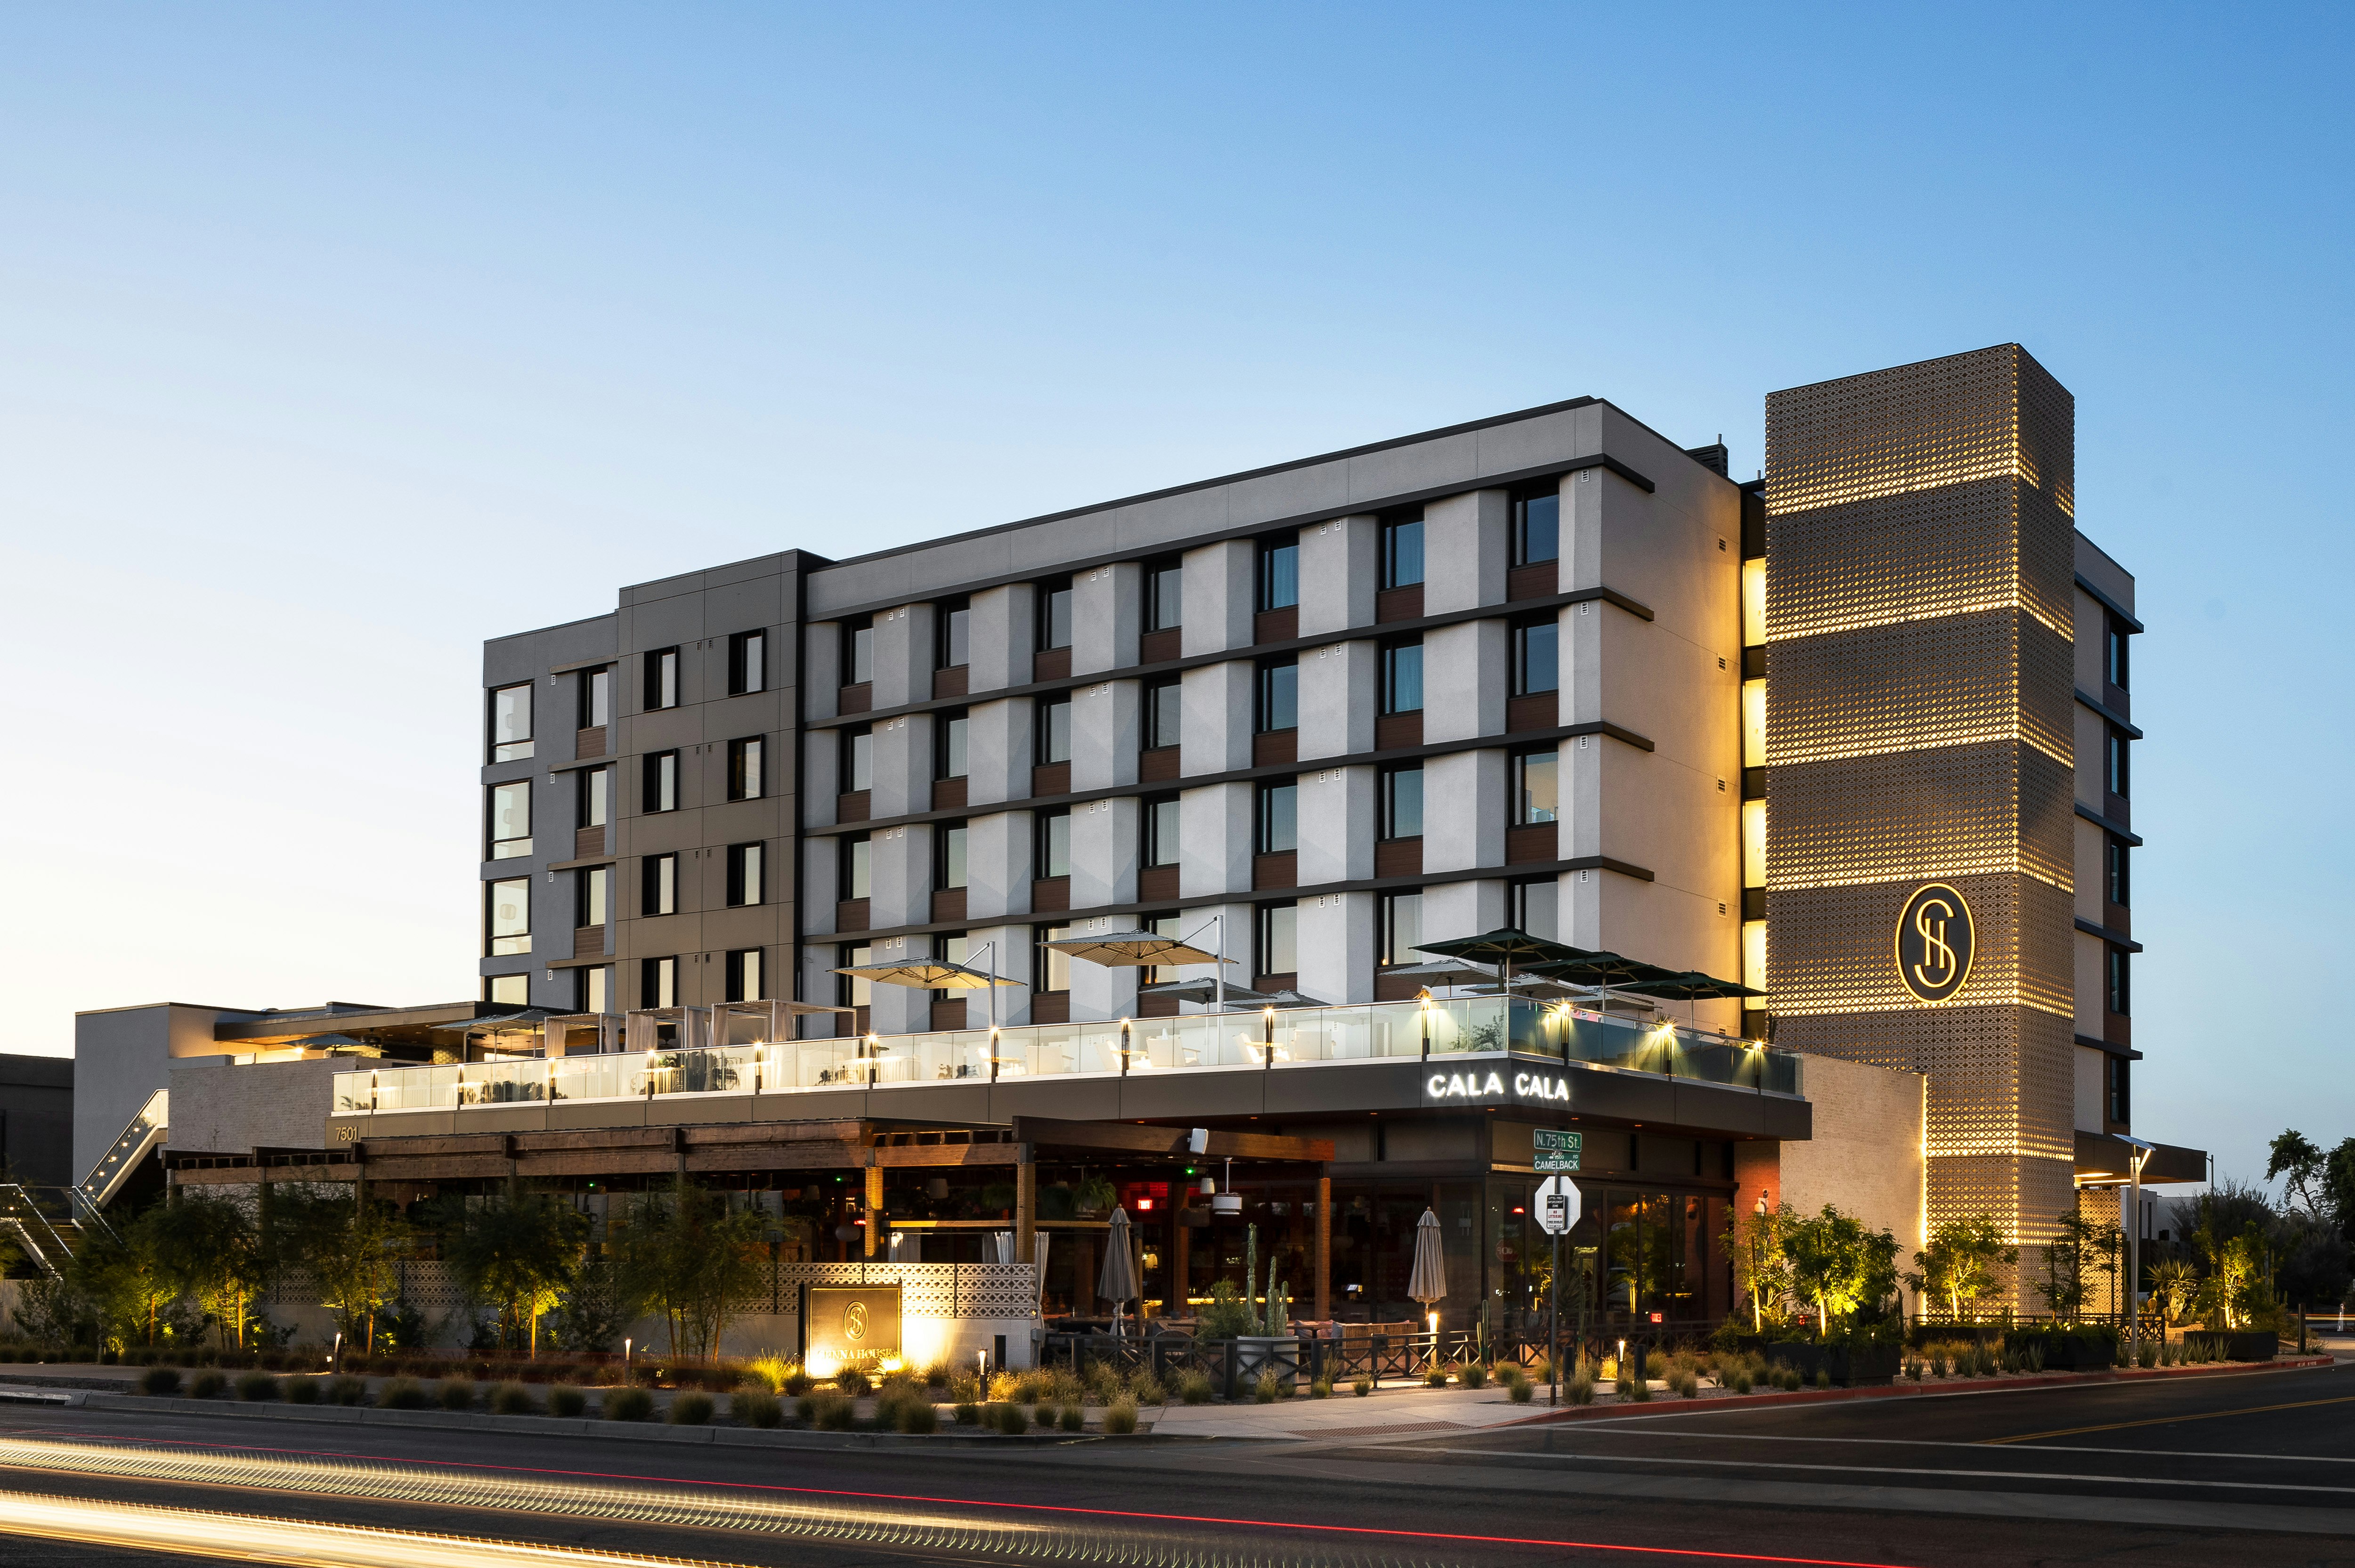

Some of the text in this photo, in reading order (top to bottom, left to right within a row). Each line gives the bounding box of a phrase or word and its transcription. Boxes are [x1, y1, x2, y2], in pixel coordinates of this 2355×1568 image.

[1428, 1073, 1504, 1097] CALA
[1515, 1073, 1569, 1101] CALA
[335, 1126, 358, 1141] 7501
[1567, 1136, 1580, 1149] St.
[1535, 1160, 1578, 1170] CAMELBACK
